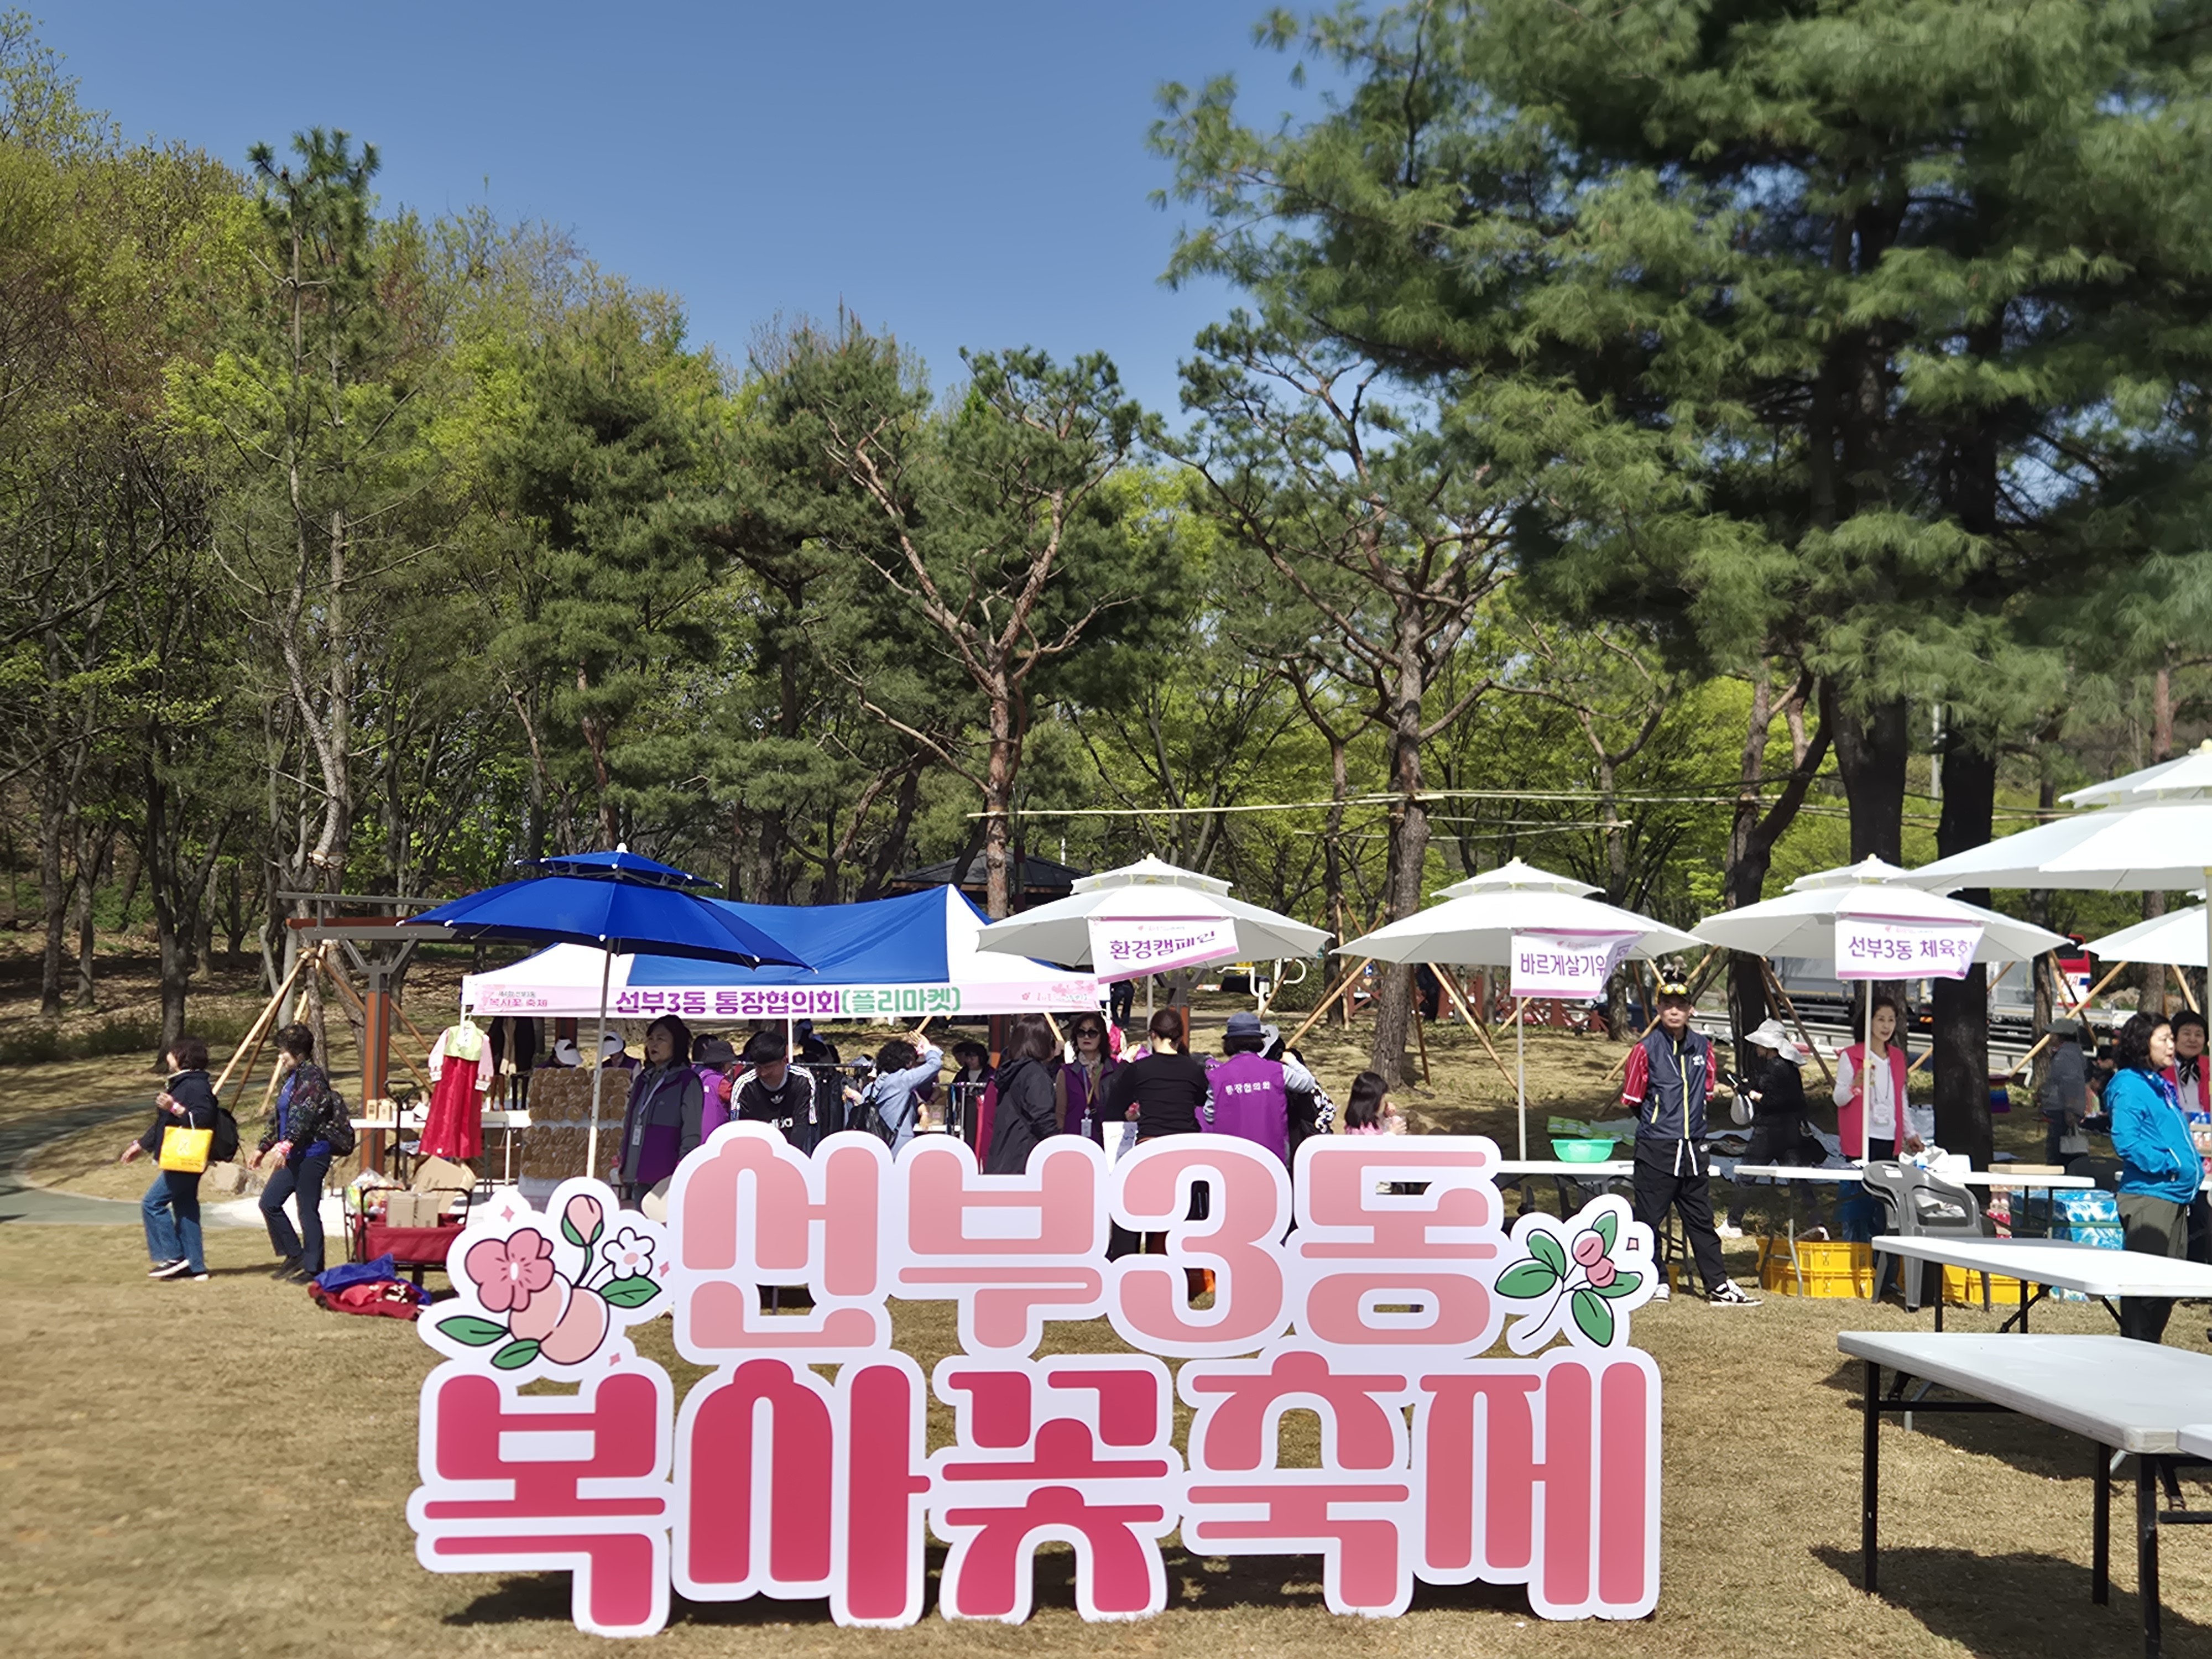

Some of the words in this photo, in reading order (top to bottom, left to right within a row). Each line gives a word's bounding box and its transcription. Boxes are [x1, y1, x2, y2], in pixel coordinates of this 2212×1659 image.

[1110, 931, 1215, 959] 환경캠페인
[1849, 936, 1912, 960] 선부3동
[489, 998, 523, 1008] 복사꽃
[526, 999, 547, 1008] 축제
[616, 991, 706, 1014] 선부3동
[715, 987, 961, 1014] 통장협의회(플리마켓)
[682, 1135, 1496, 1348] 선부3동
